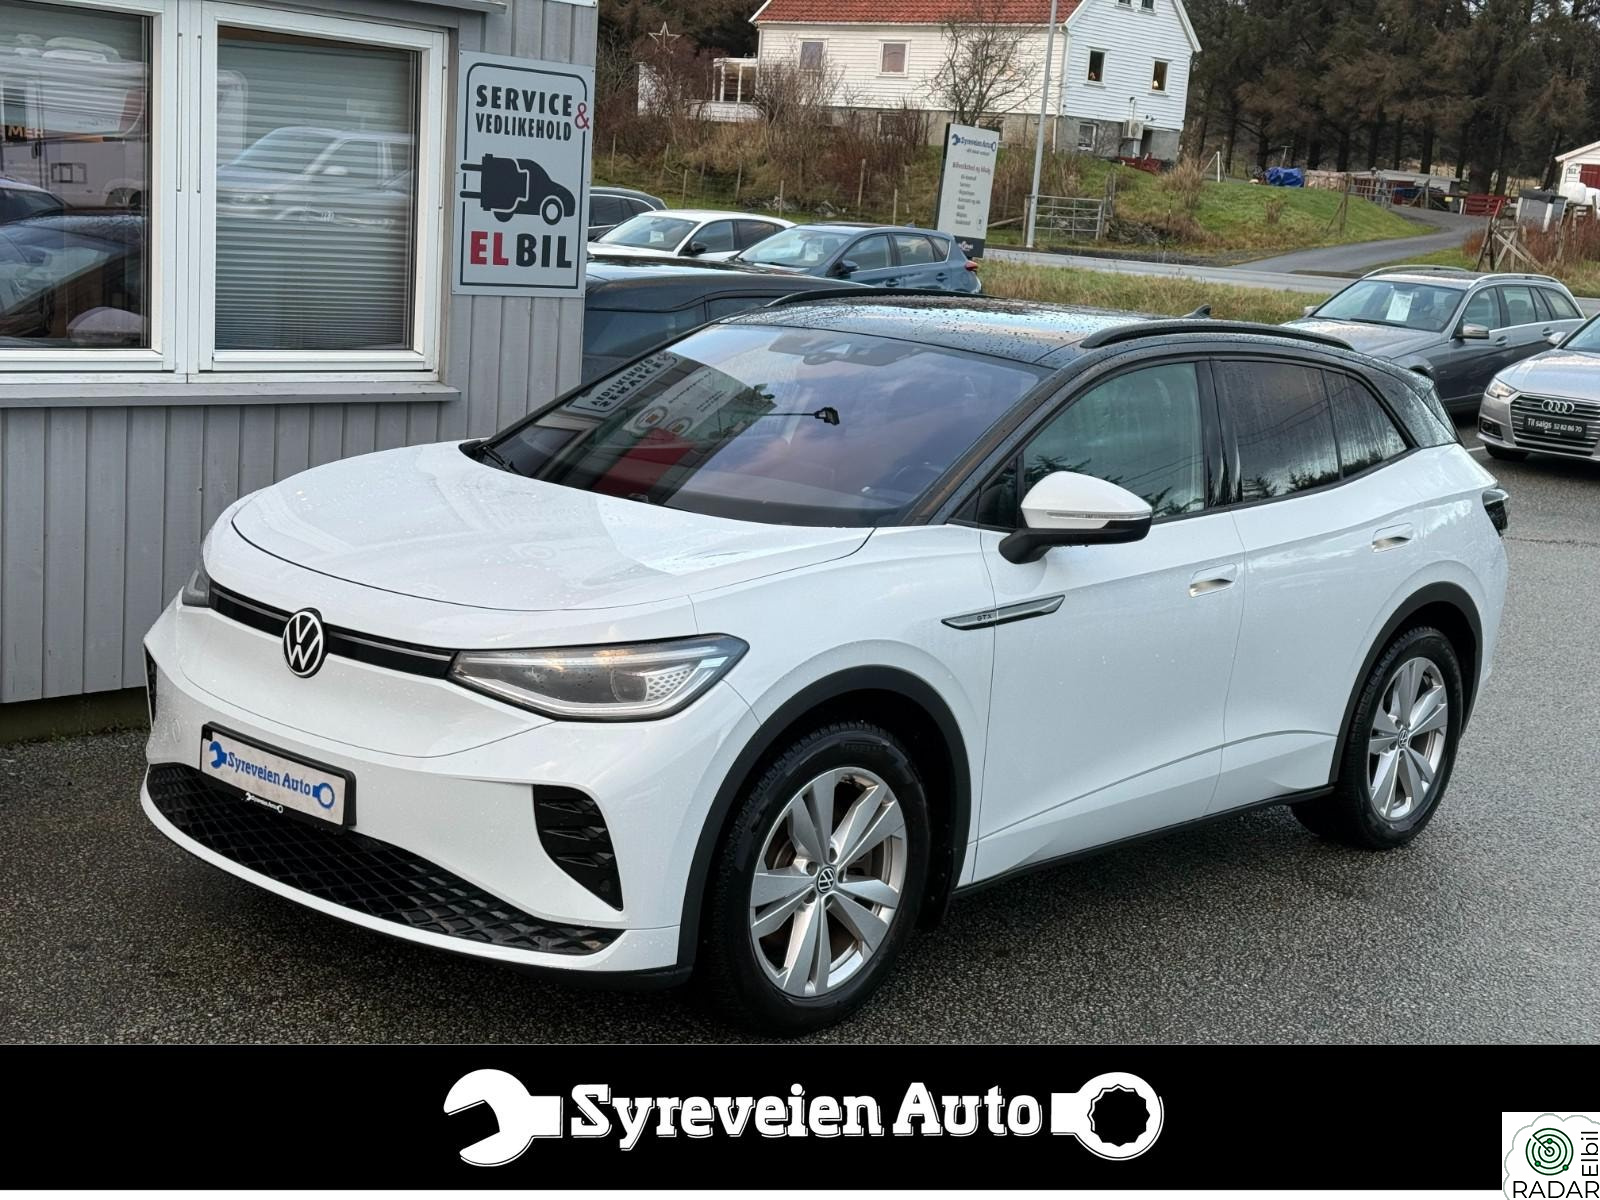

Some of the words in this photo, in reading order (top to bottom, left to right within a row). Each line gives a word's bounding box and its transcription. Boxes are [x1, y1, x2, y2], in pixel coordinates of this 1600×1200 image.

[476, 84, 573, 117] SERVICE
[574, 102, 590, 130] &
[475, 112, 572, 141] VEDLIKEHOLD
[976, 613, 993, 622] GTX
[227, 751, 281, 786] Syreveien
[281, 772, 312, 796] Auto
